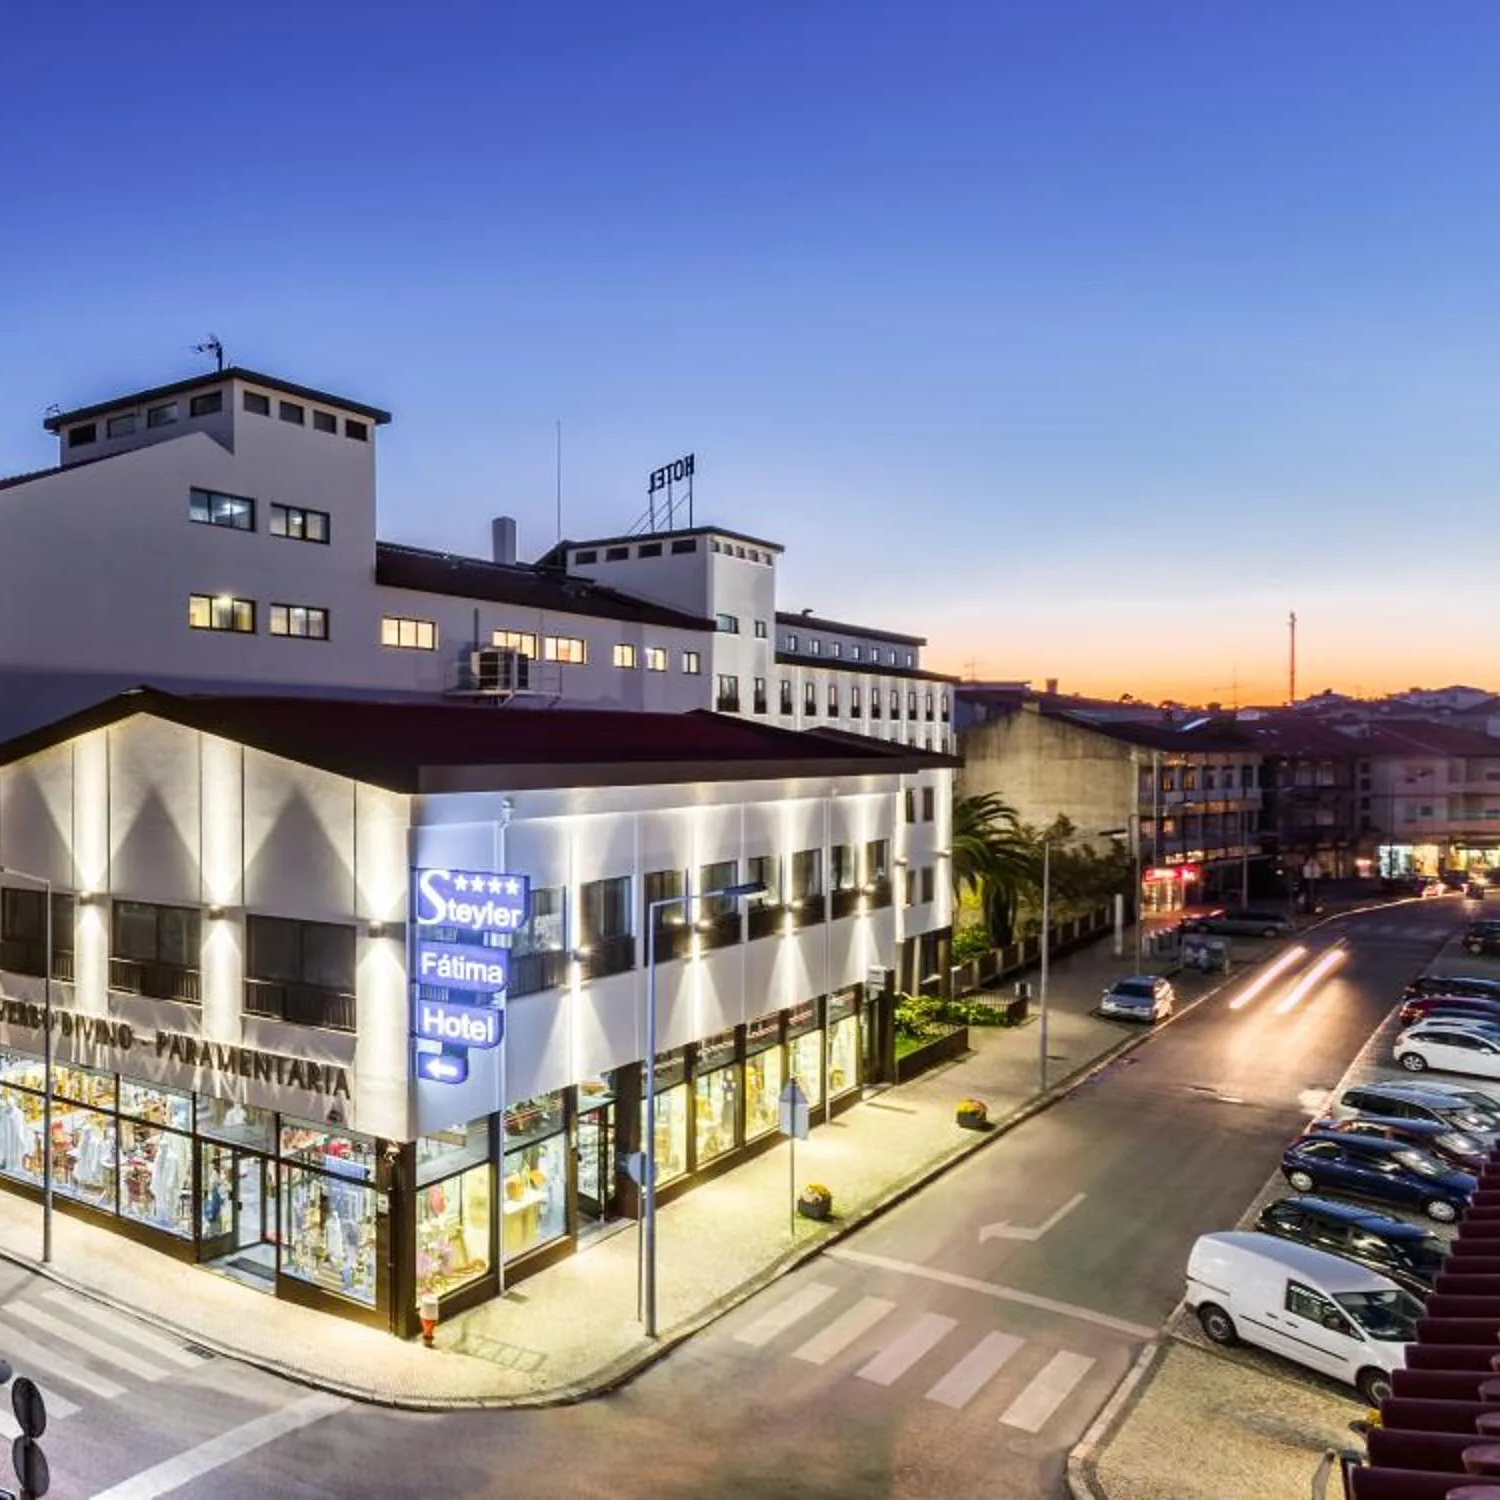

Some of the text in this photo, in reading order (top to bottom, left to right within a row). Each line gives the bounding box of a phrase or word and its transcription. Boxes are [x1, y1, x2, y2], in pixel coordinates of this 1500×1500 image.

[417, 870, 523, 931] Steyler
[420, 950, 504, 985] Fátima
[422, 1006, 494, 1043] Hotel
[61, 1011, 133, 1051] DIVINO
[156, 1031, 351, 1100] PARAMENTARIA
